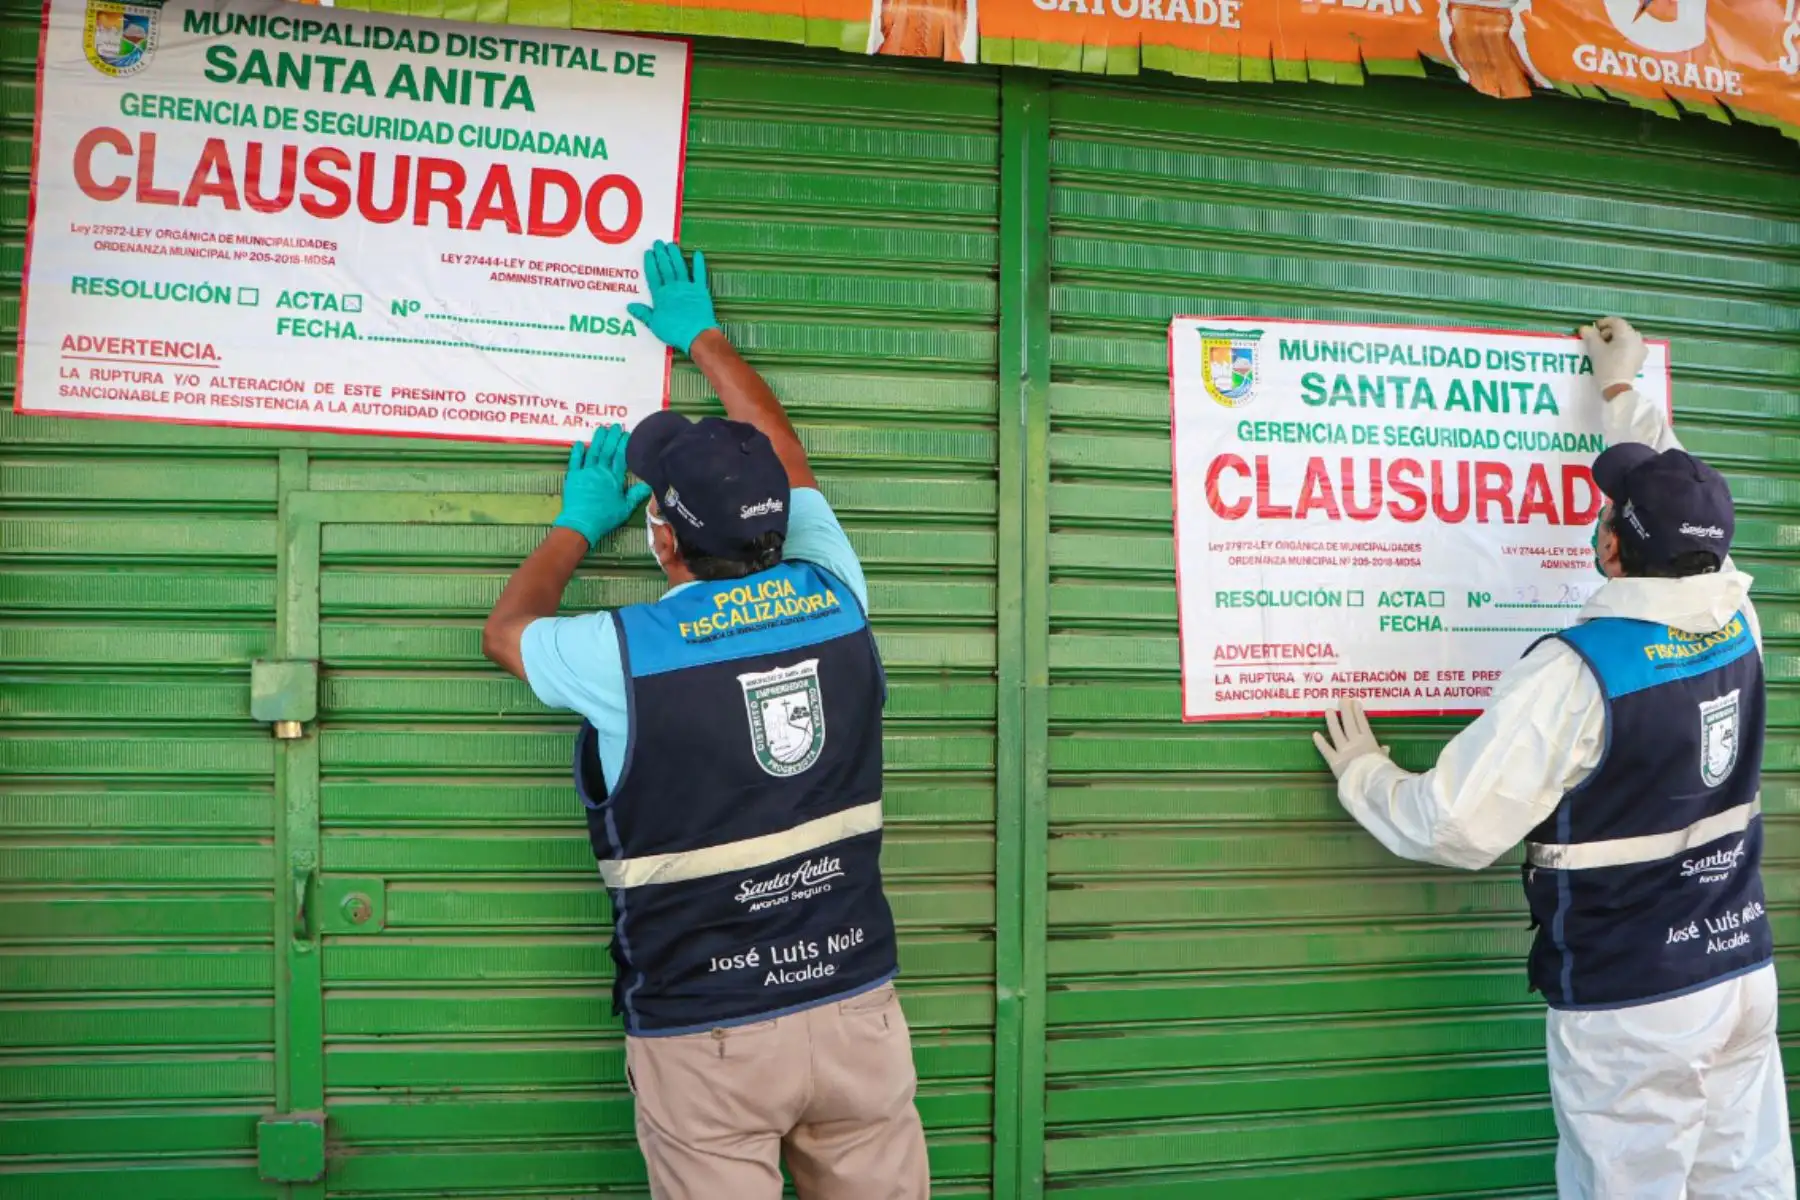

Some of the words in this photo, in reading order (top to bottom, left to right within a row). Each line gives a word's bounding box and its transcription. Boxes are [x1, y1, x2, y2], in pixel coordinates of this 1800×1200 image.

[183, 9, 440, 52] MUNICIPALIDAD
[446, 33, 608, 72] DISTRITAL
[614, 52, 656, 77] DE
[204, 45, 376, 97] SANTA
[386, 64, 535, 112] ANITA
[1572, 44, 1744, 96] GATORADE
[120, 92, 257, 127] GERENCIA
[263, 108, 298, 130] DE
[302, 111, 456, 145] SEGURIDAD
[458, 124, 608, 160] CIUDADANA
[73, 126, 643, 245] CLAUSURADO
[70, 223, 91, 236] Ley
[92, 224, 152, 238] 27972-LEY
[155, 228, 218, 243] ORGÁNICA
[218, 232, 234, 244] DE
[235, 234, 337, 251] MUNICIPALIDADES
[94, 241, 167, 256] ORDENANZA
[169, 247, 231, 260] MUNICIPAL
[441, 253, 463, 264] LEY
[464, 255, 525, 268] 27444-LEY
[528, 261, 543, 271] DE
[545, 262, 639, 279] PROCEDIMIENTO
[489, 272, 586, 290] ADMINISTRATIVO
[587, 280, 640, 294] GENERAL
[71, 276, 231, 305] RESOLUCIÓN
[276, 289, 338, 313] ACTA
[569, 314, 637, 337] MDSA
[61, 334, 222, 362] ADVERTENCIA.
[1279, 339, 1481, 369] MUNICIPALIDAD
[1486, 348, 1594, 376] DISTRITA
[59, 384, 169, 404] SANCIONABLE
[173, 391, 205, 405] POR
[210, 394, 309, 412] RESISTENCIA
[312, 400, 325, 412] A
[328, 400, 348, 413] LA
[351, 401, 438, 419] AUTORIDAD
[442, 406, 505, 424] (CODIGO
[510, 412, 558, 427] PENAL
[60, 366, 79, 379] LA
[90, 368, 163, 385] RUPTURA
[174, 373, 200, 387] Y/O
[210, 375, 305, 395] ALTERACIÓN
[314, 382, 334, 395] DE
[344, 383, 382, 397] ESTE
[391, 386, 466, 402] PRESINTO
[475, 390, 568, 411] CONSTITUYE
[575, 402, 628, 418] DELITO
[1300, 372, 1437, 410] SANTA
[1444, 378, 1559, 416] ANITA
[1237, 420, 1347, 445] GERENCIA
[1351, 425, 1380, 446] DE
[1384, 426, 1500, 450] SEGURIDAD
[1503, 430, 1605, 453] CIUDADAN
[1204, 453, 1602, 526] CLAUSURAD
[1208, 542, 1223, 552] Ley
[1326, 542, 1339, 552] DE
[1228, 556, 1286, 566] ORDENANZA
[1288, 556, 1339, 566] MUNICIPAL
[1567, 547, 1578, 556] DE
[1541, 559, 1593, 569] ADMINISTRA
[713, 578, 796, 610] POLICIA
[1215, 588, 1342, 608] RESOLUCIÓN
[1378, 591, 1427, 608] ACTA
[678, 589, 840, 638] FISCALIZADORA
[1213, 643, 1339, 661] ADVERTENCIA.
[1215, 673, 1231, 685] LA
[1240, 672, 1295, 684] RUPTURA
[1304, 672, 1323, 683] Y/O
[1331, 670, 1406, 682] ALTERACIÓN
[1414, 671, 1429, 682] DE
[1437, 671, 1465, 681] ESTE
[1472, 670, 1501, 681] PRES
[1215, 688, 1300, 701] SANCIONABLE
[1304, 688, 1328, 699] POR
[1332, 687, 1410, 699] RESISTENCIA
[1414, 687, 1422, 697] A
[1426, 687, 1441, 697] LA
[1680, 849, 1734, 877] Santa
[735, 872, 792, 903] Santa
[790, 856, 845, 886] Anita
[792, 884, 831, 901] Seguro
[1665, 921, 1700, 944] José
[1704, 910, 1740, 934] Luis
[1706, 930, 1750, 954] Alcalde
[709, 947, 760, 972] José
[771, 940, 819, 965] Luis
[827, 927, 865, 954] Nole
[764, 962, 836, 986] Alcalde
